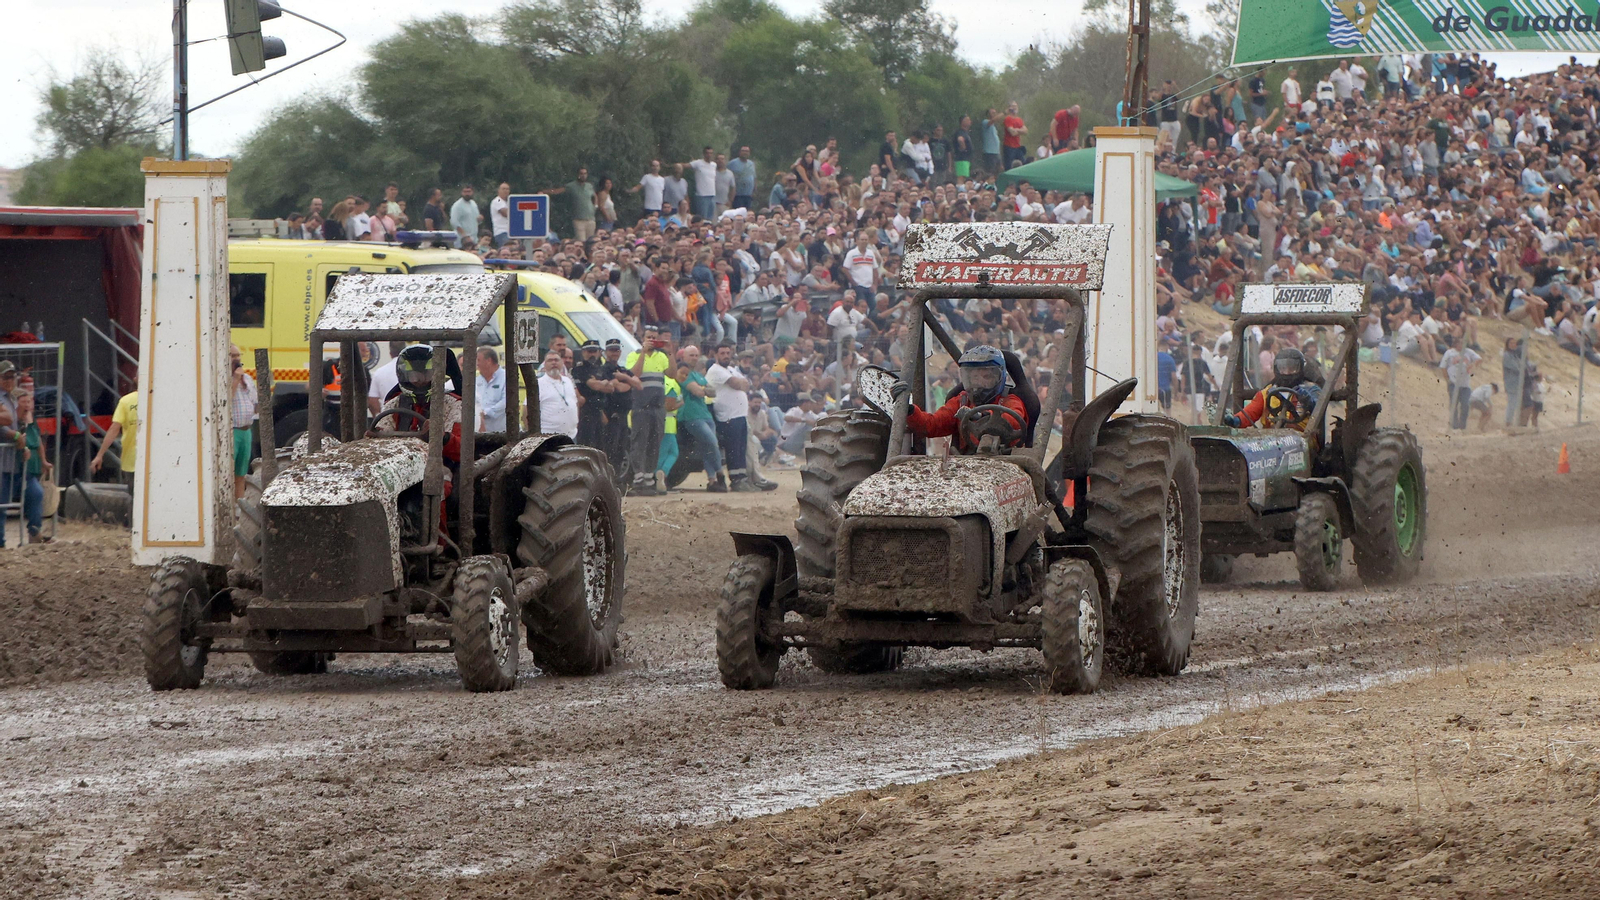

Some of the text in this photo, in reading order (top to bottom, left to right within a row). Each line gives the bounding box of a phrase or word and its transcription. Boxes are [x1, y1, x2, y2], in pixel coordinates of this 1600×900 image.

[1432, 7, 1471, 33] de
[921, 265, 1081, 281] MAFERAUTO
[352, 283, 421, 297] TURBO
[1275, 288, 1331, 304] ASFDECOR
[304, 268, 313, 342] www.cbpc.es
[517, 318, 537, 350] 05
